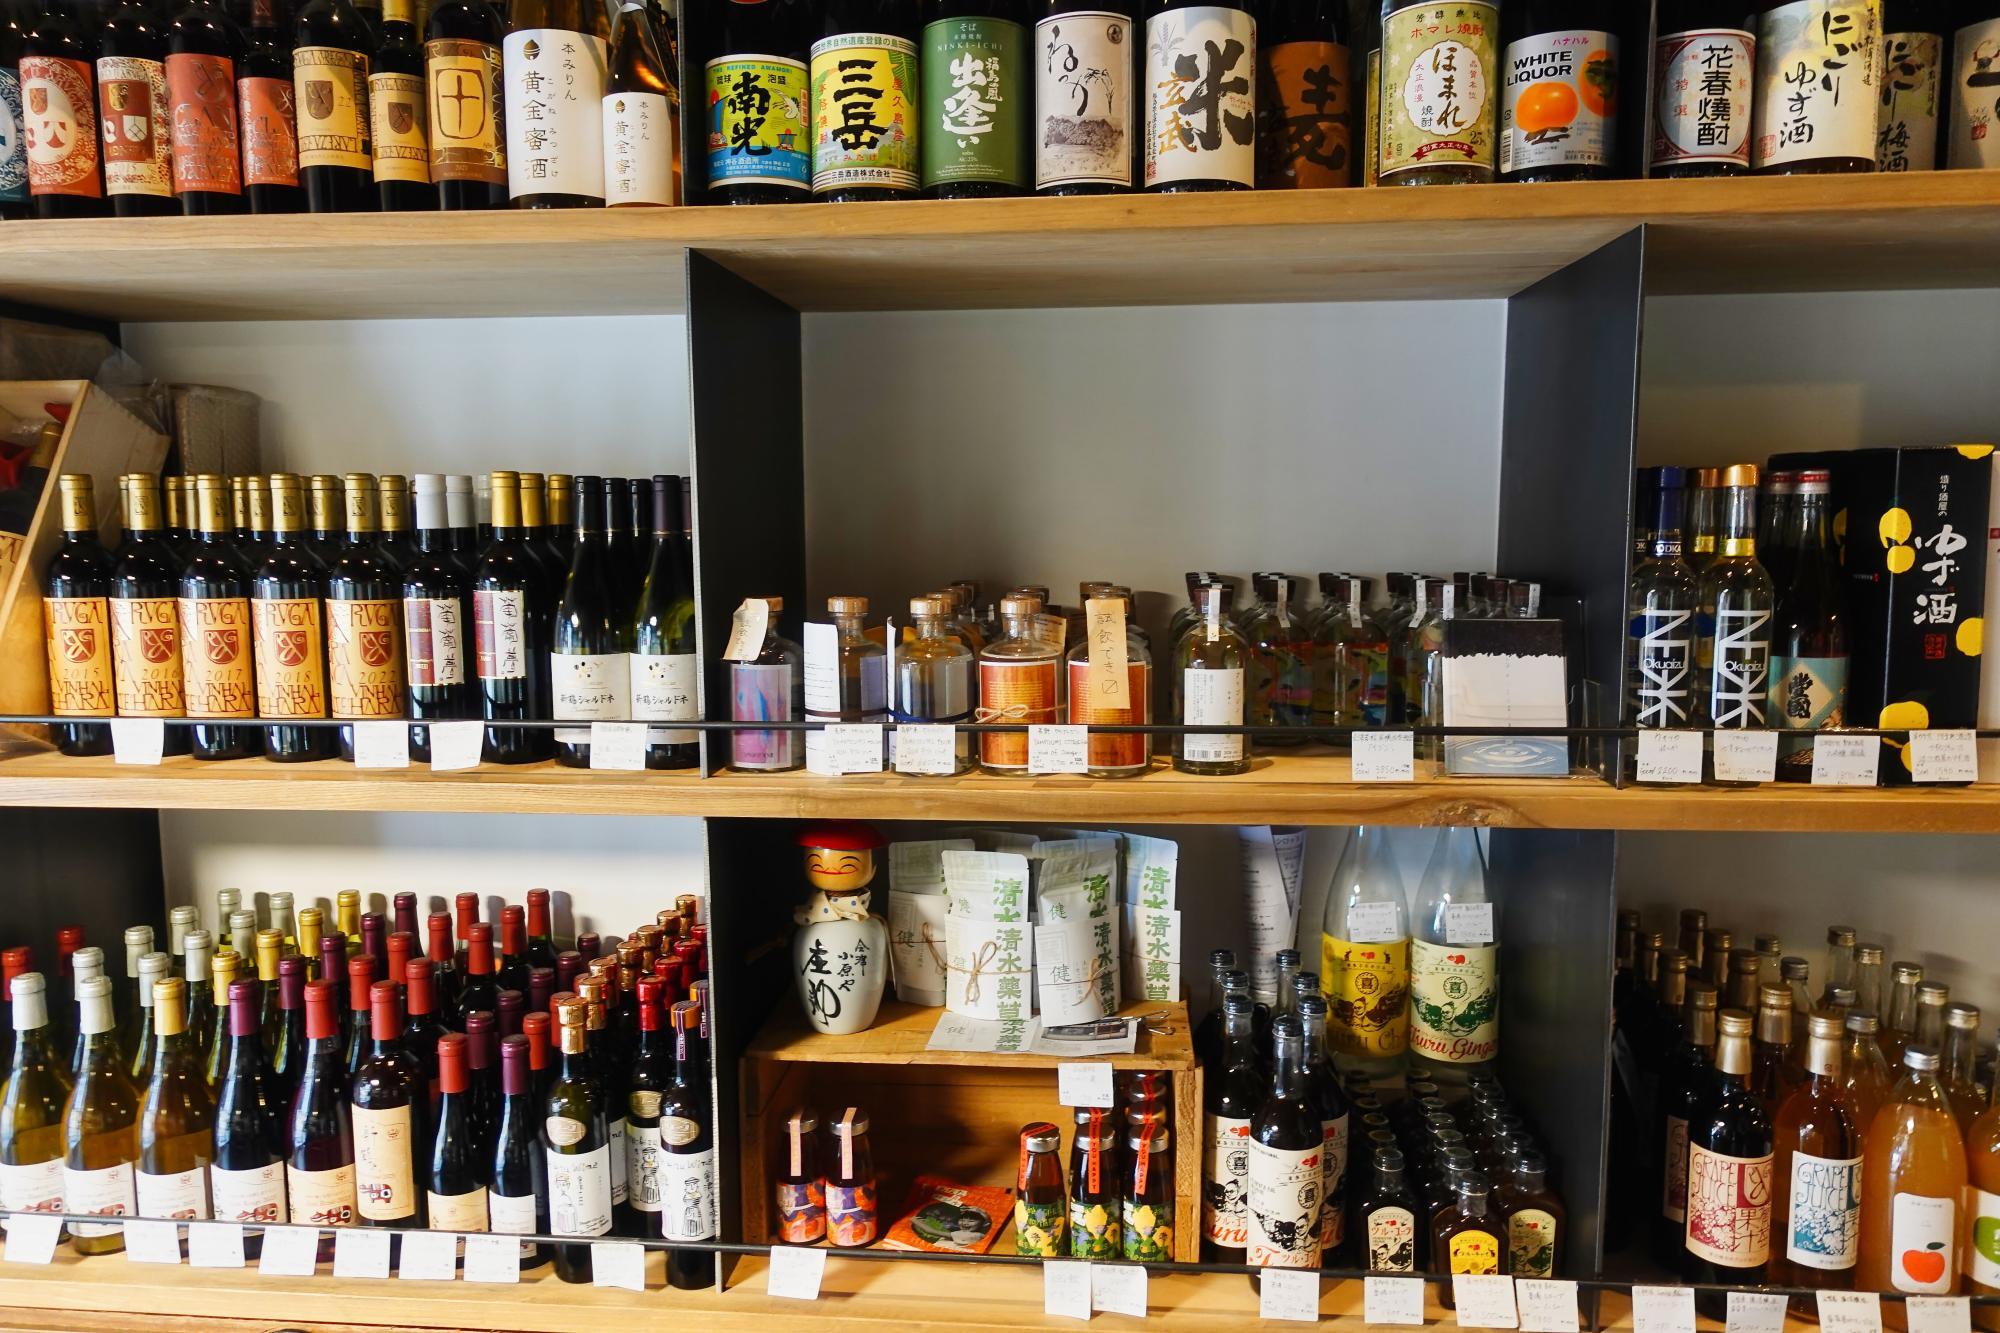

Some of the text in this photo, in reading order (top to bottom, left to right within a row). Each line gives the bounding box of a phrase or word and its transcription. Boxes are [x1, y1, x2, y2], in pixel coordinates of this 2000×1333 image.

[960, 23, 977, 32] そば
[1411, 23, 1485, 39] ホマレ焼酎
[1553, 37, 1590, 46] ハナハル
[937, 41, 1003, 53] NINKI-ICHI
[1513, 51, 1573, 70] WHITE
[561, 43, 576, 101] 本みりん
[1432, 46, 1468, 129] ほまれ
[1507, 64, 1573, 87] LIQUOR
[832, 59, 889, 151] 三岳
[1178, 38, 1254, 151] 米
[1779, 61, 1817, 148] ゆず酒
[521, 70, 549, 179] 黄金蜜酒
[639, 100, 649, 141] 本みりん
[728, 71, 773, 156] 南光
[615, 121, 631, 193] 黄金蜜酒
[1913, 524, 1968, 625] ゆず酒
[1049, 964, 1073, 984] 健
[1691, 1152, 1737, 1185] GRAPE
[1797, 1162, 1848, 1189] GRAPE
[1690, 1174, 1737, 1208] JUICE
[1796, 1182, 1848, 1212] JUICE
[1734, 1209, 1760, 1253] 果汁
